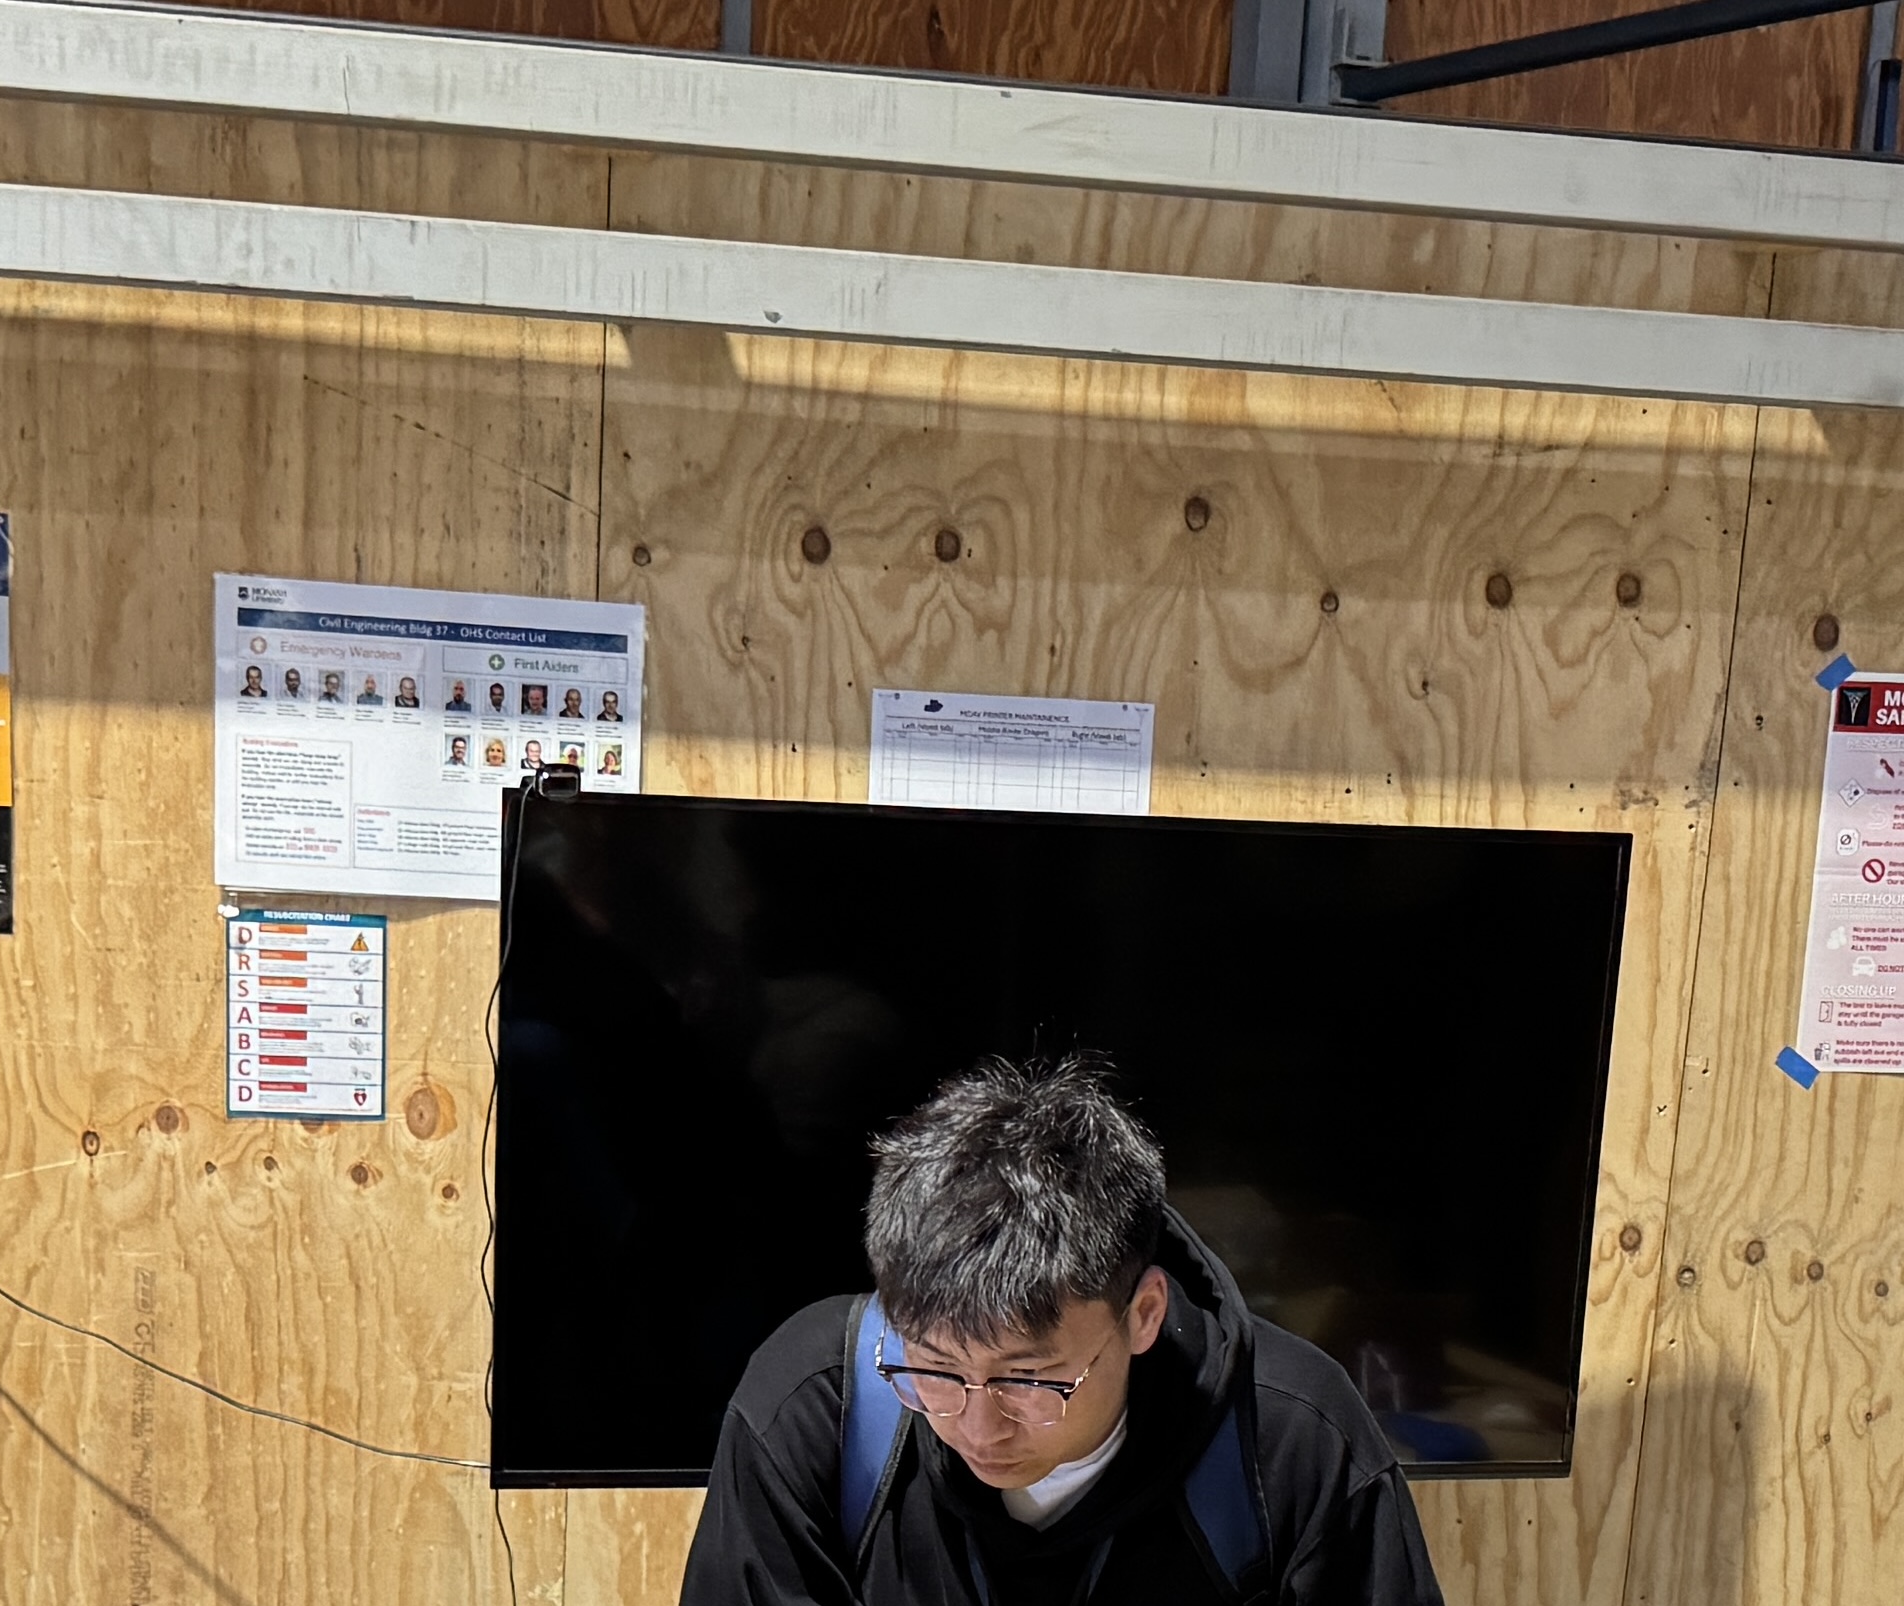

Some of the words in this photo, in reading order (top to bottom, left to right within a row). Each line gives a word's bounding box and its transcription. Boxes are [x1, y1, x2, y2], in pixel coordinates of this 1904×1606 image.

[318, 616, 341, 629] Civil
[344, 618, 406, 634] Engineering
[409, 623, 433, 638] Bldg
[435, 625, 448, 637] 37
[460, 627, 483, 639] OHS
[485, 629, 526, 642] Contact
[528, 632, 546, 643] List
[280, 642, 347, 659] Emergency
[350, 645, 402, 661] Wardens
[514, 657, 541, 672] First
[542, 660, 579, 673] Aiders
[1831, 893, 1871, 905] AFTER
[238, 926, 252, 945] D
[239, 954, 252, 971] R
[238, 980, 250, 998] S
[1822, 985, 1877, 996] CLOSING
[1879, 986, 1897, 997] UP
[237, 1006, 252, 1024] A
[239, 1033, 251, 1050] B
[238, 1058, 251, 1076] C
[239, 1085, 252, 1102] D
